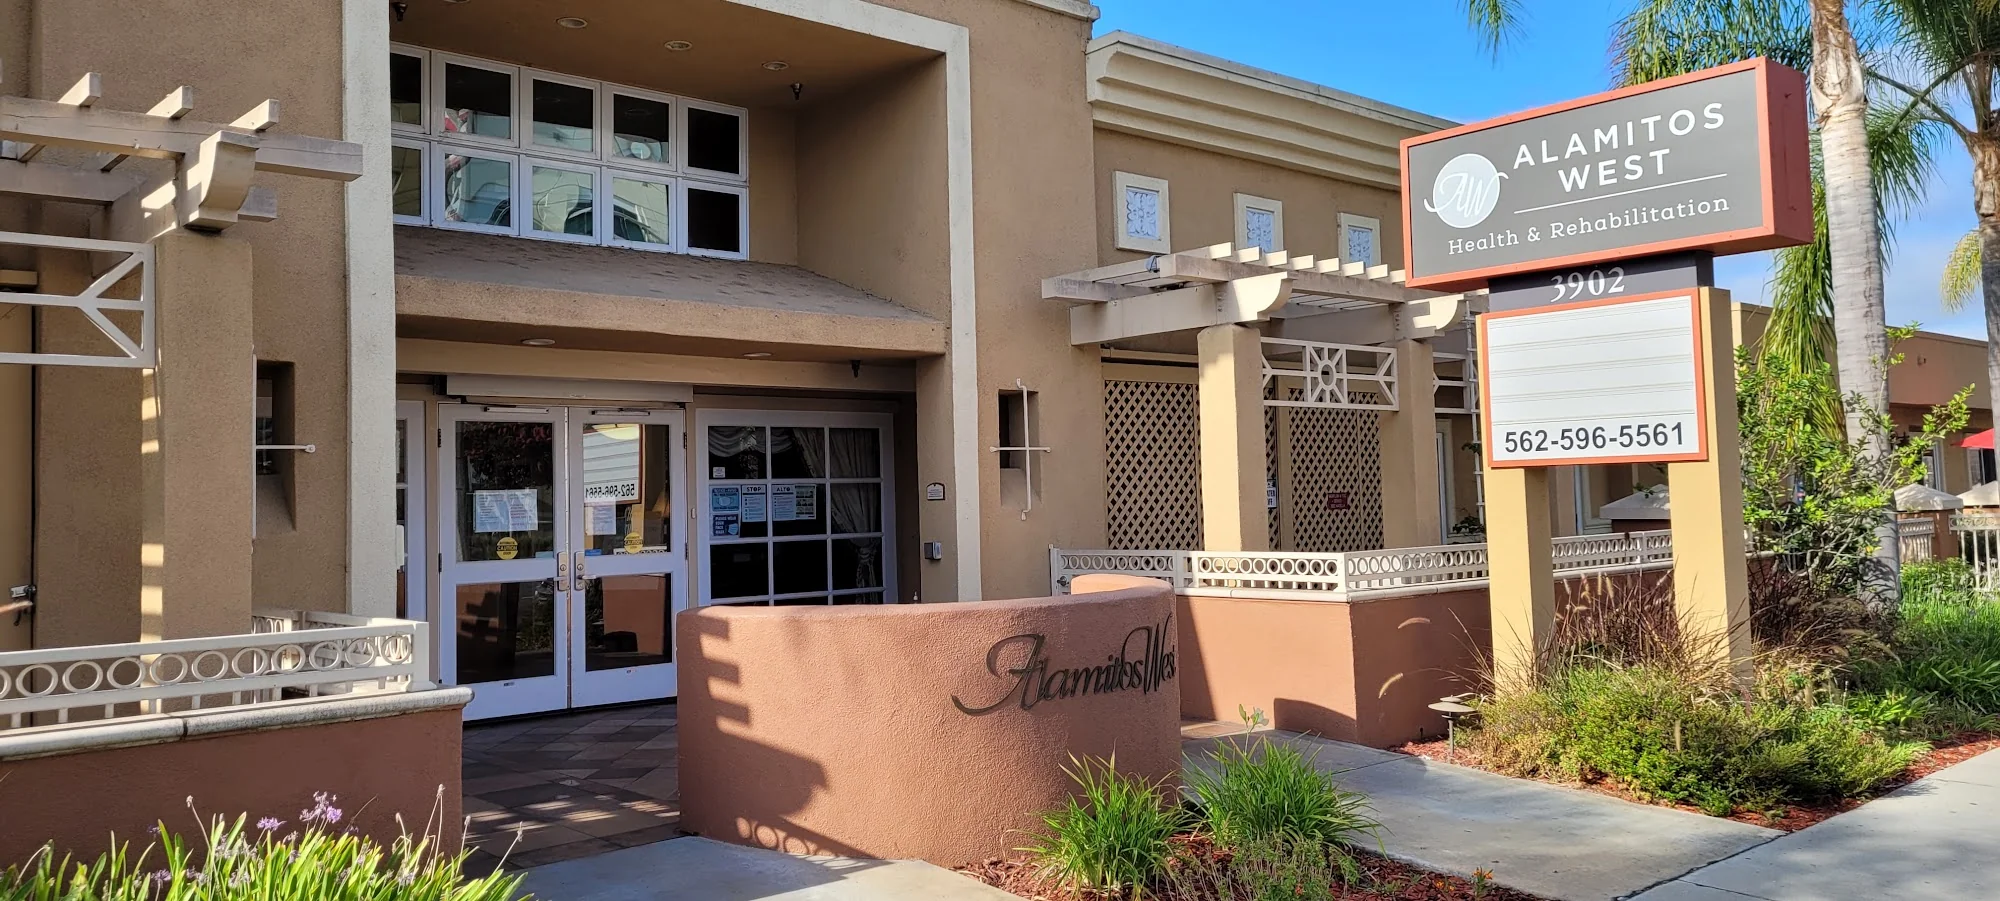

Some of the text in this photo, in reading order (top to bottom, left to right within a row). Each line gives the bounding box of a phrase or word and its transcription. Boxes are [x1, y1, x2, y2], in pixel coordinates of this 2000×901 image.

[1512, 102, 1726, 170] ALAMITOS
[1557, 148, 1671, 193] WEST
[1448, 196, 1730, 256] Health & Rehabilitation
[1549, 266, 1626, 303] 3902
[1504, 421, 1685, 454] 562-596-5561
[951, 633, 1144, 717] Alamitos
